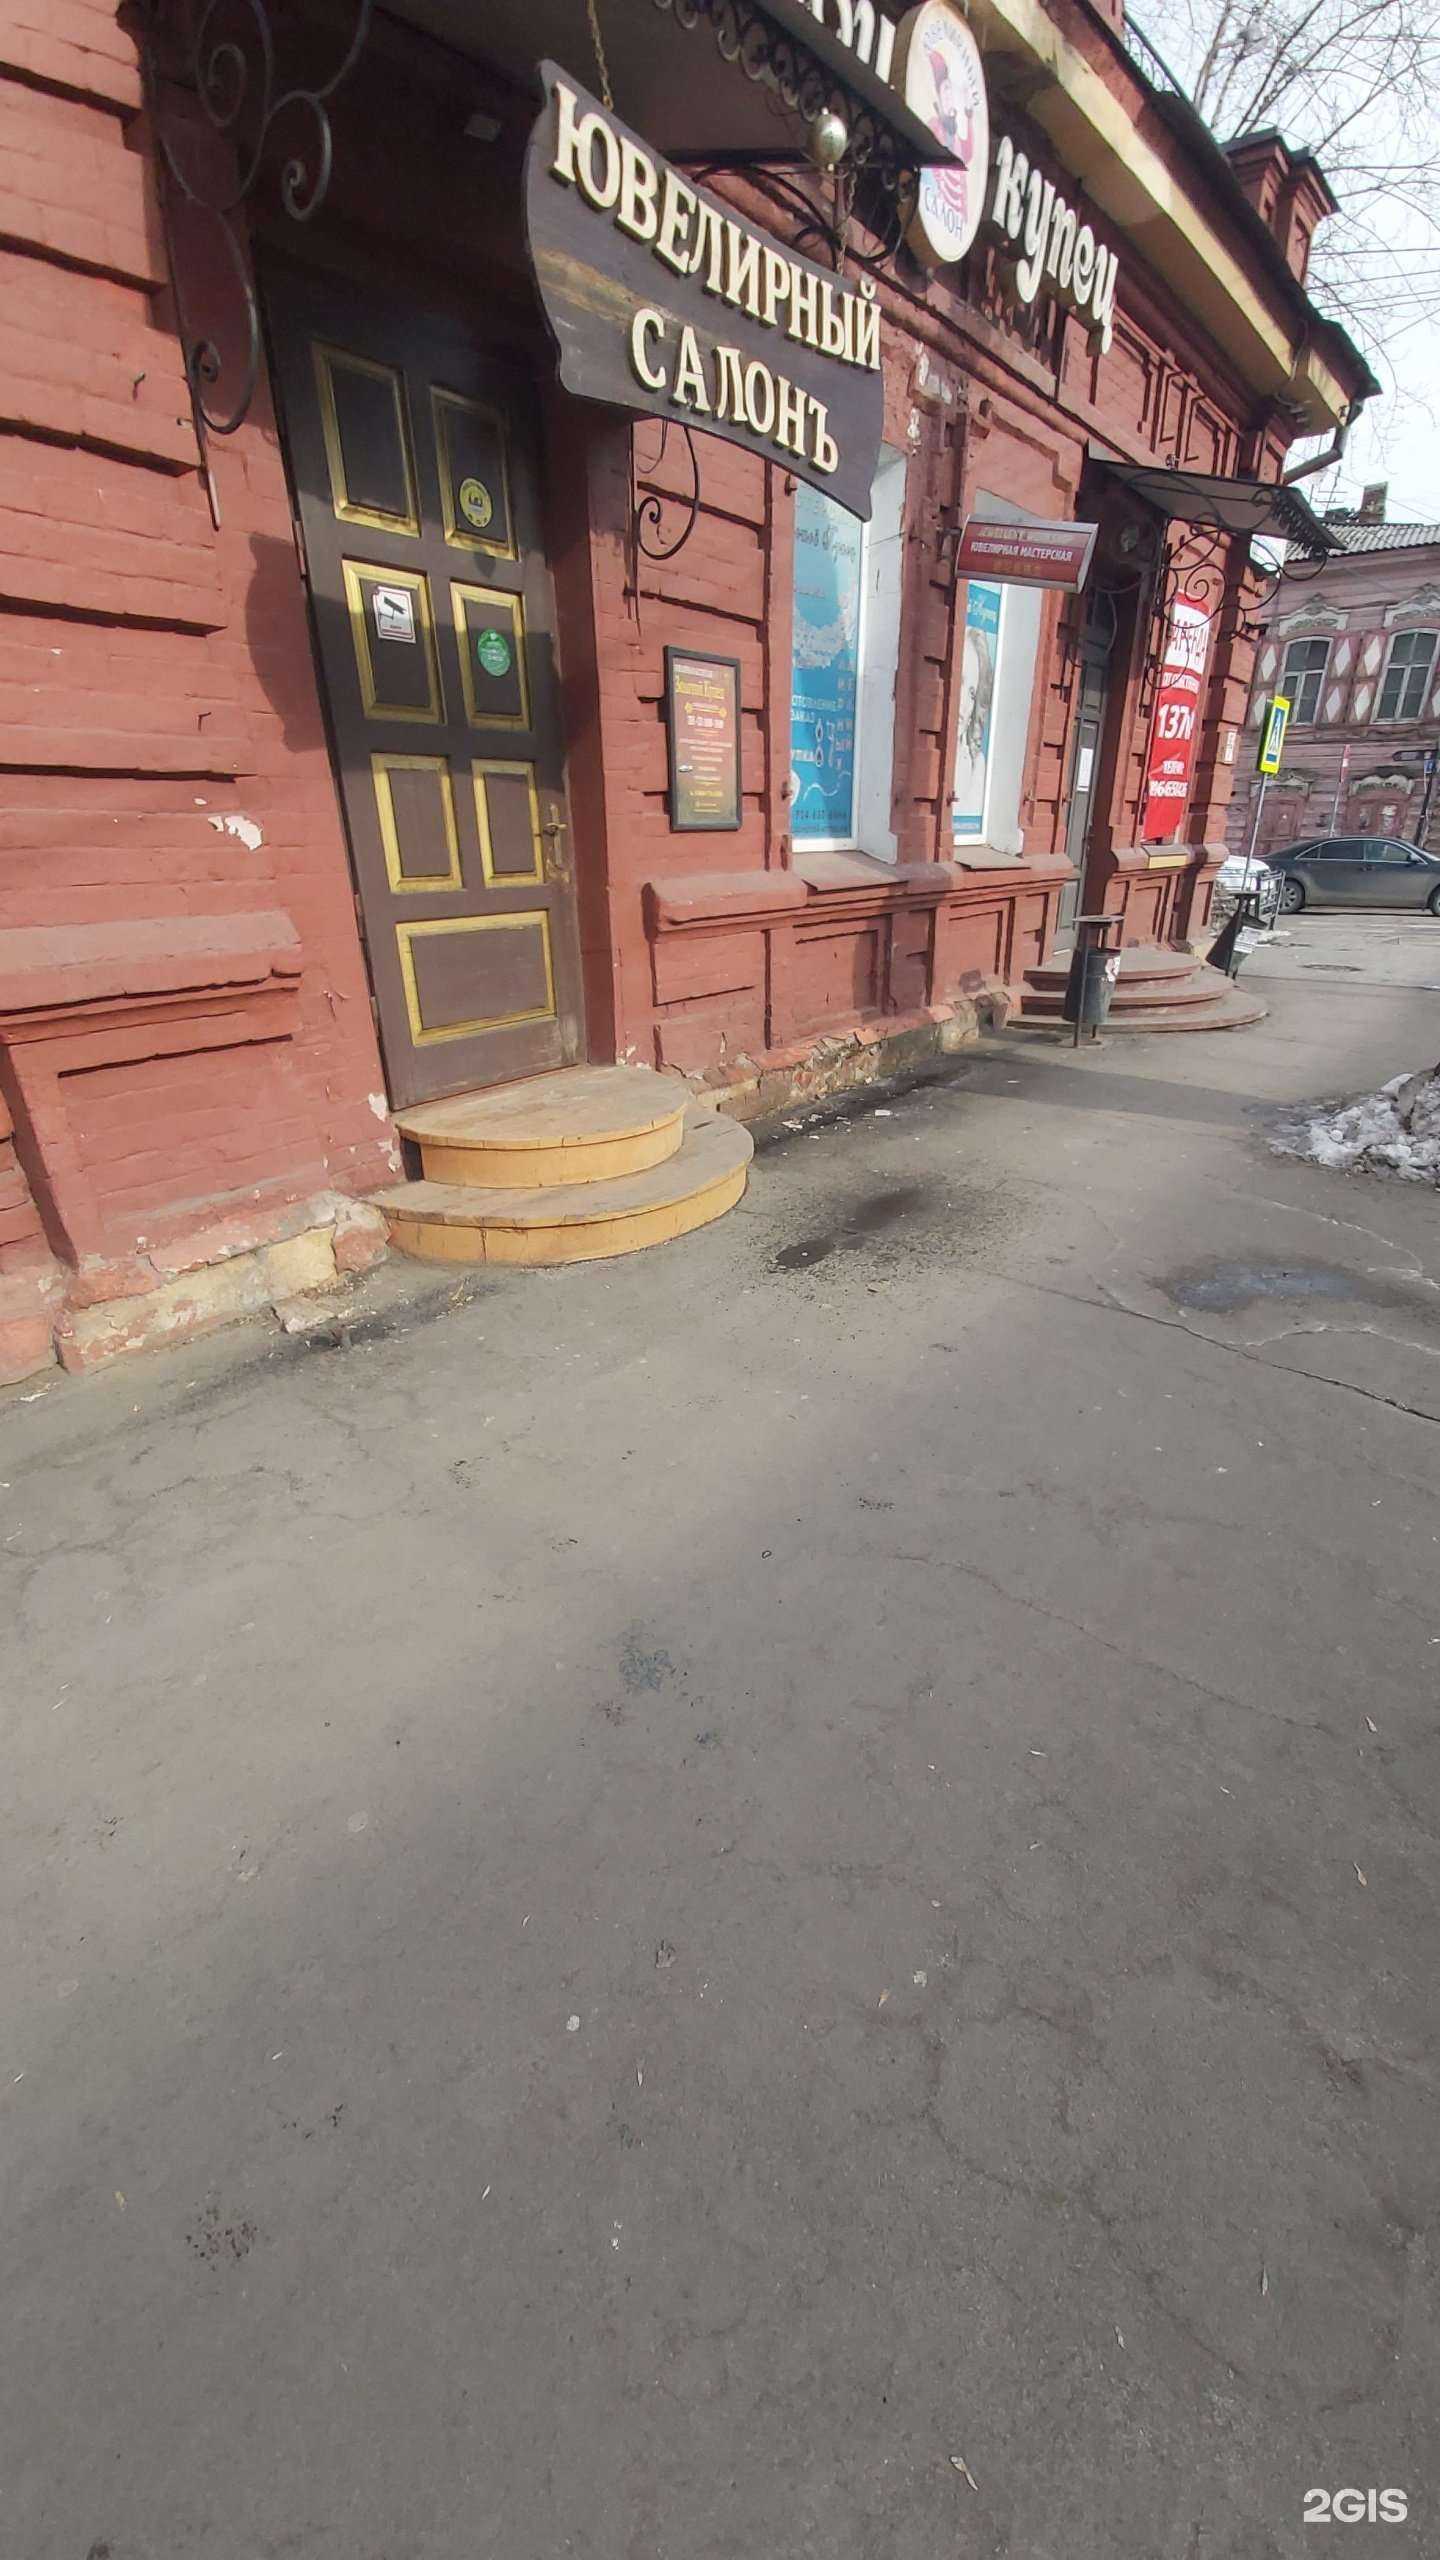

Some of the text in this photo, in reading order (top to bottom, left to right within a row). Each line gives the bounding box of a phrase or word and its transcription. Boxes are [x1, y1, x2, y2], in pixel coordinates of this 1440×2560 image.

[553, 80, 882, 370] ЮВЕЛИРНЫЙ
[631, 308, 839, 474] САЛОНЪ
[970, 541, 1073, 562] ЮВЕЛИРНАЯ МАСТЕРСКАЯ
